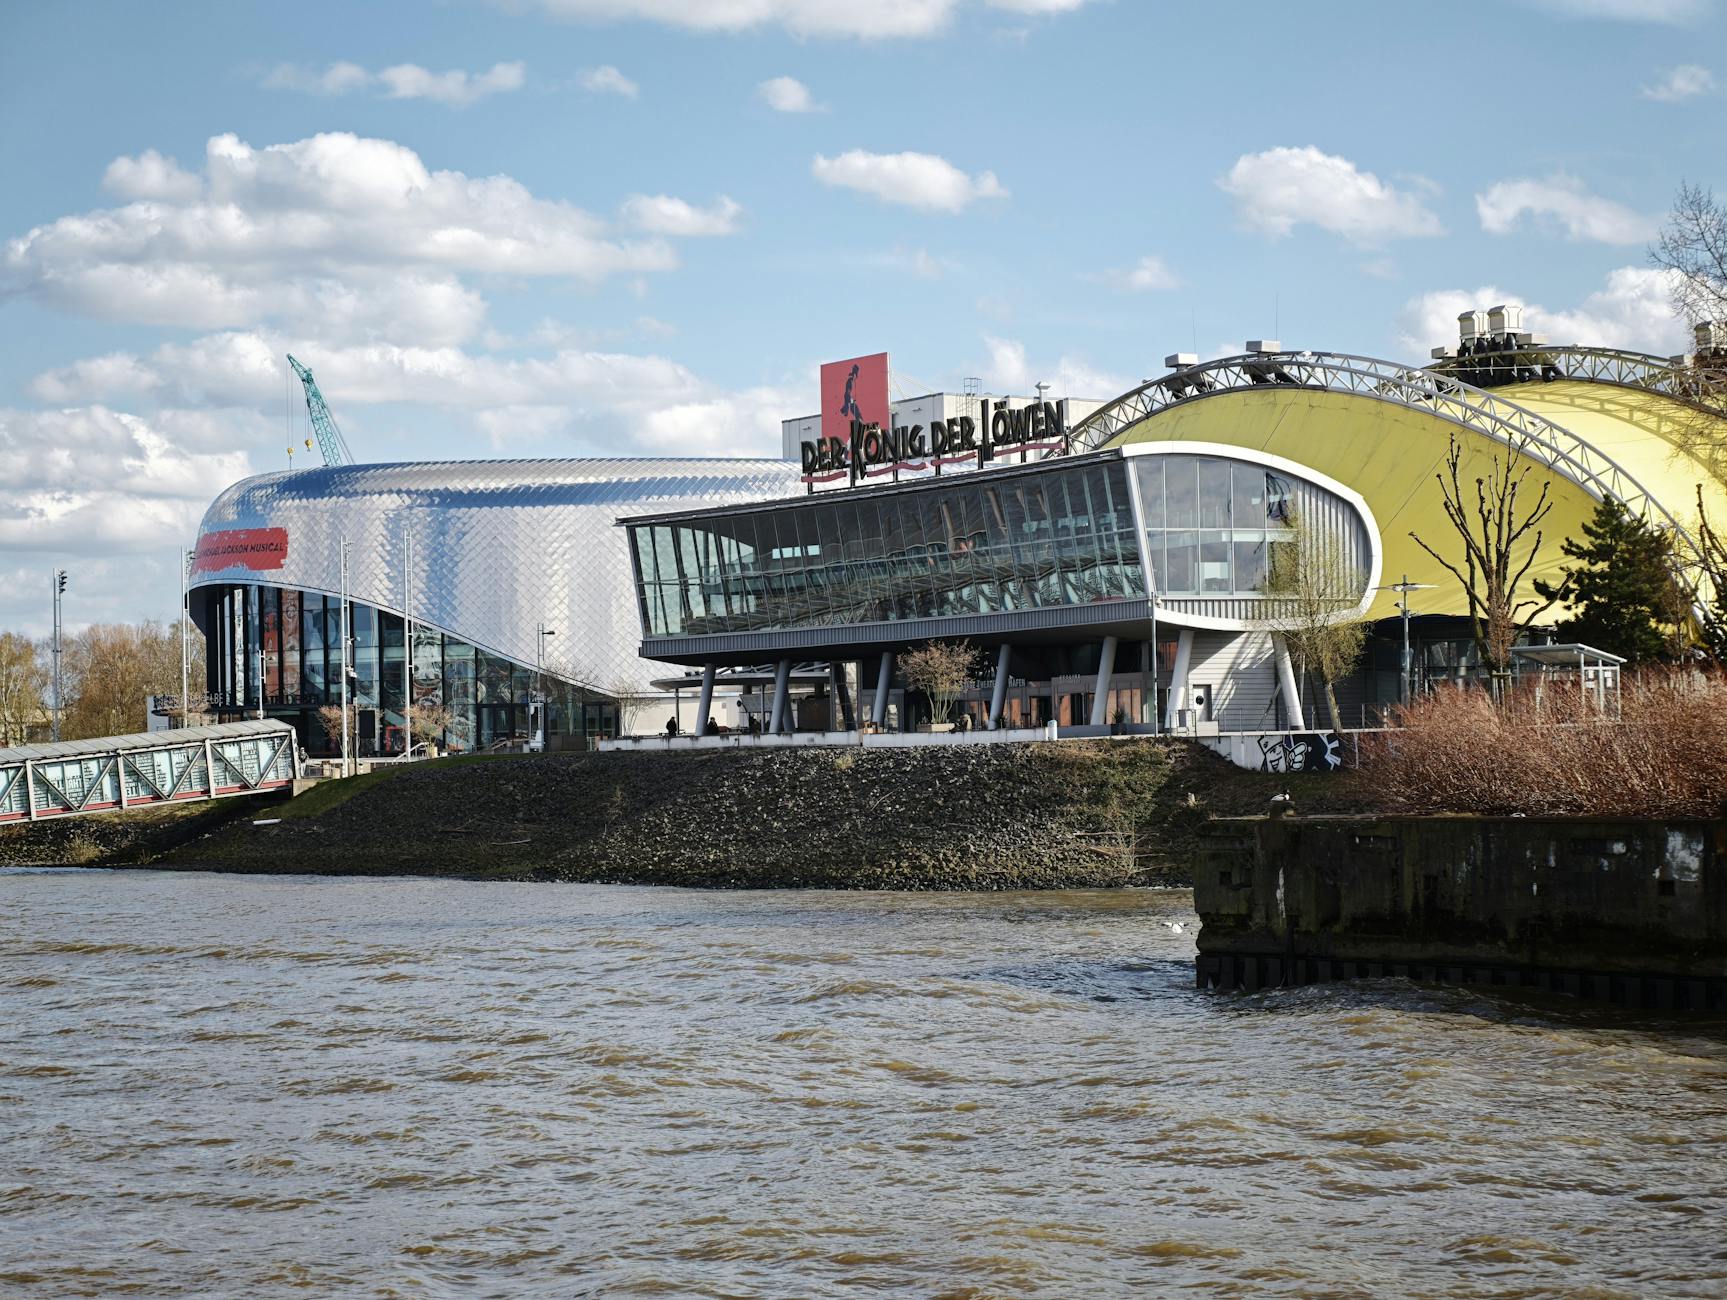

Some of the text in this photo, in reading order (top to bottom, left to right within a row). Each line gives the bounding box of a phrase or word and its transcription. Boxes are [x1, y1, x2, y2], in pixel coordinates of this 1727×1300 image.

[801, 399, 1064, 480] DER KÖNIG DER LÖWEN
[249, 542, 284, 553] MUSICAL
